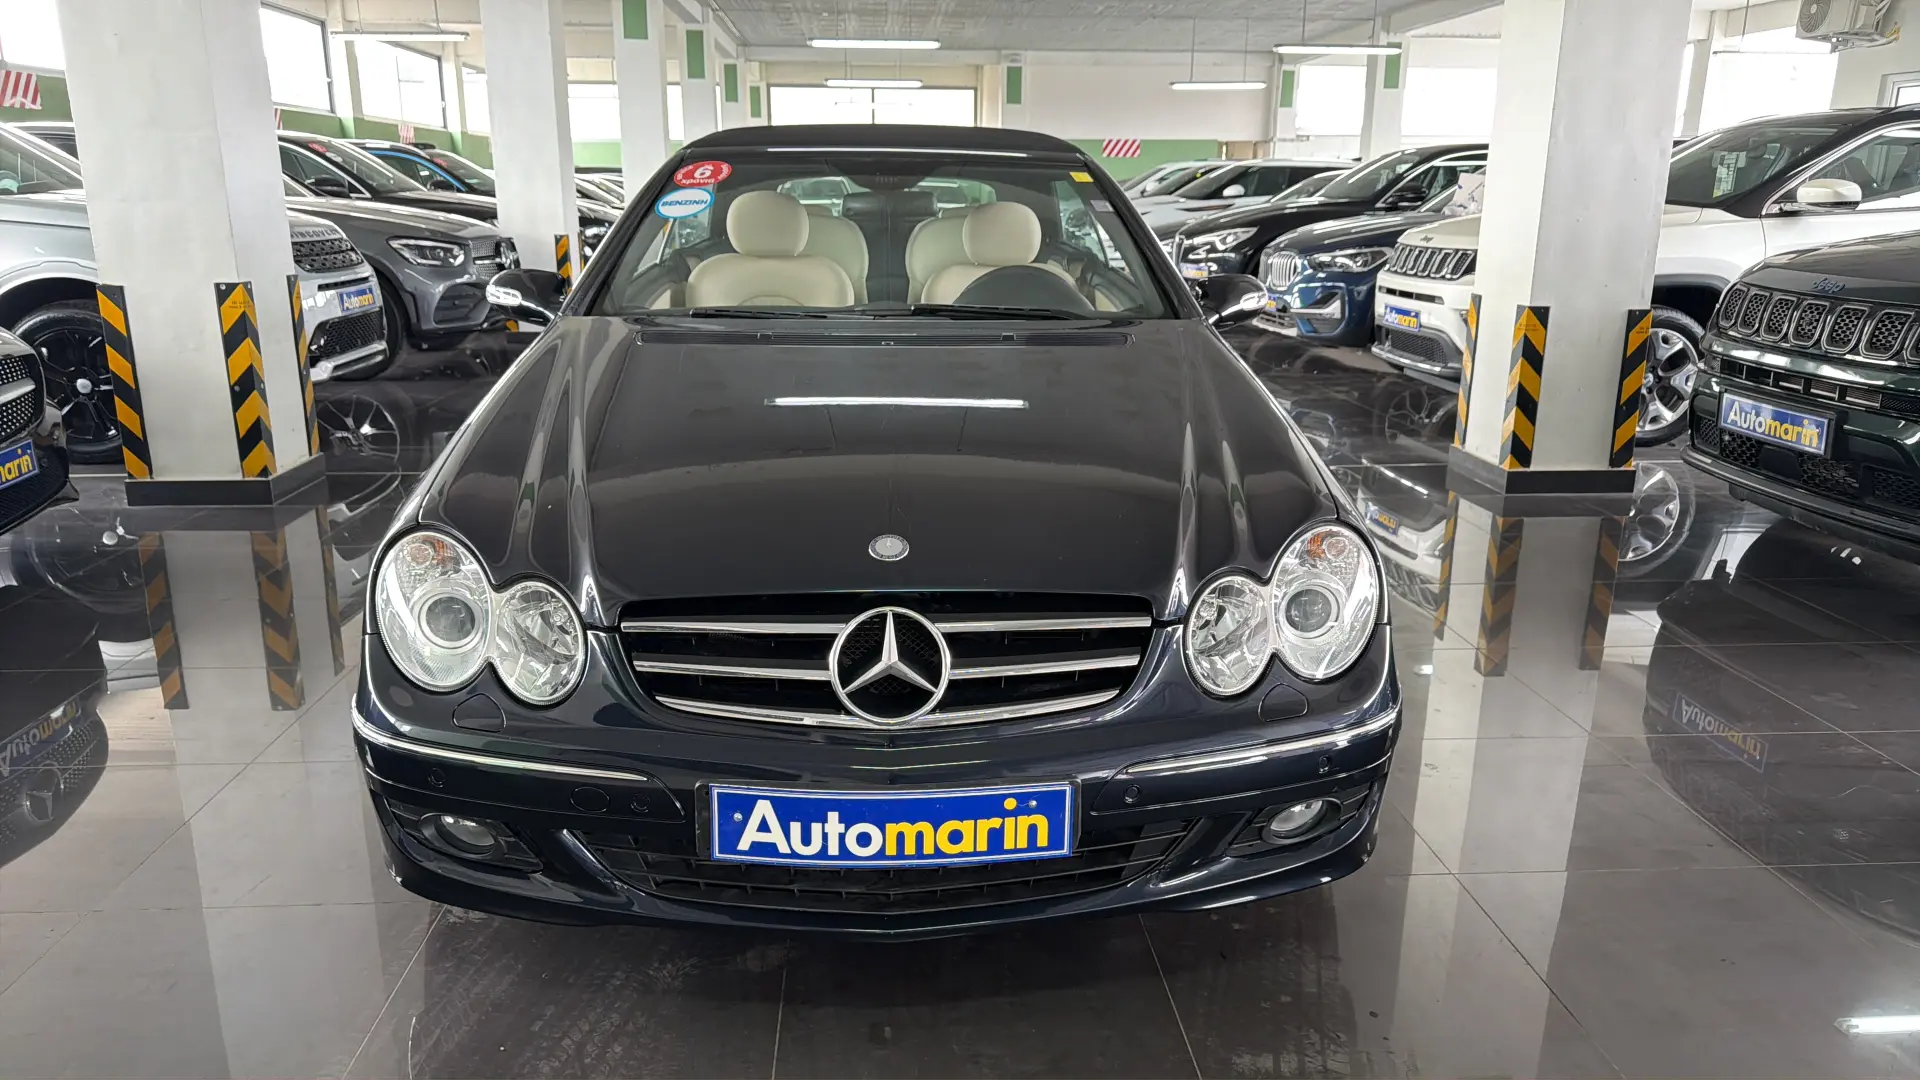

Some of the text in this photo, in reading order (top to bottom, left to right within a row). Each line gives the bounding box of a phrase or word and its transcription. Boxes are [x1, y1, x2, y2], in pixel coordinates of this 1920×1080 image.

[694, 165, 714, 178] 6
[1812, 276, 1846, 293] Jeep
[1727, 401, 1818, 448] Automarin
[737, 797, 1048, 857] Automarin
